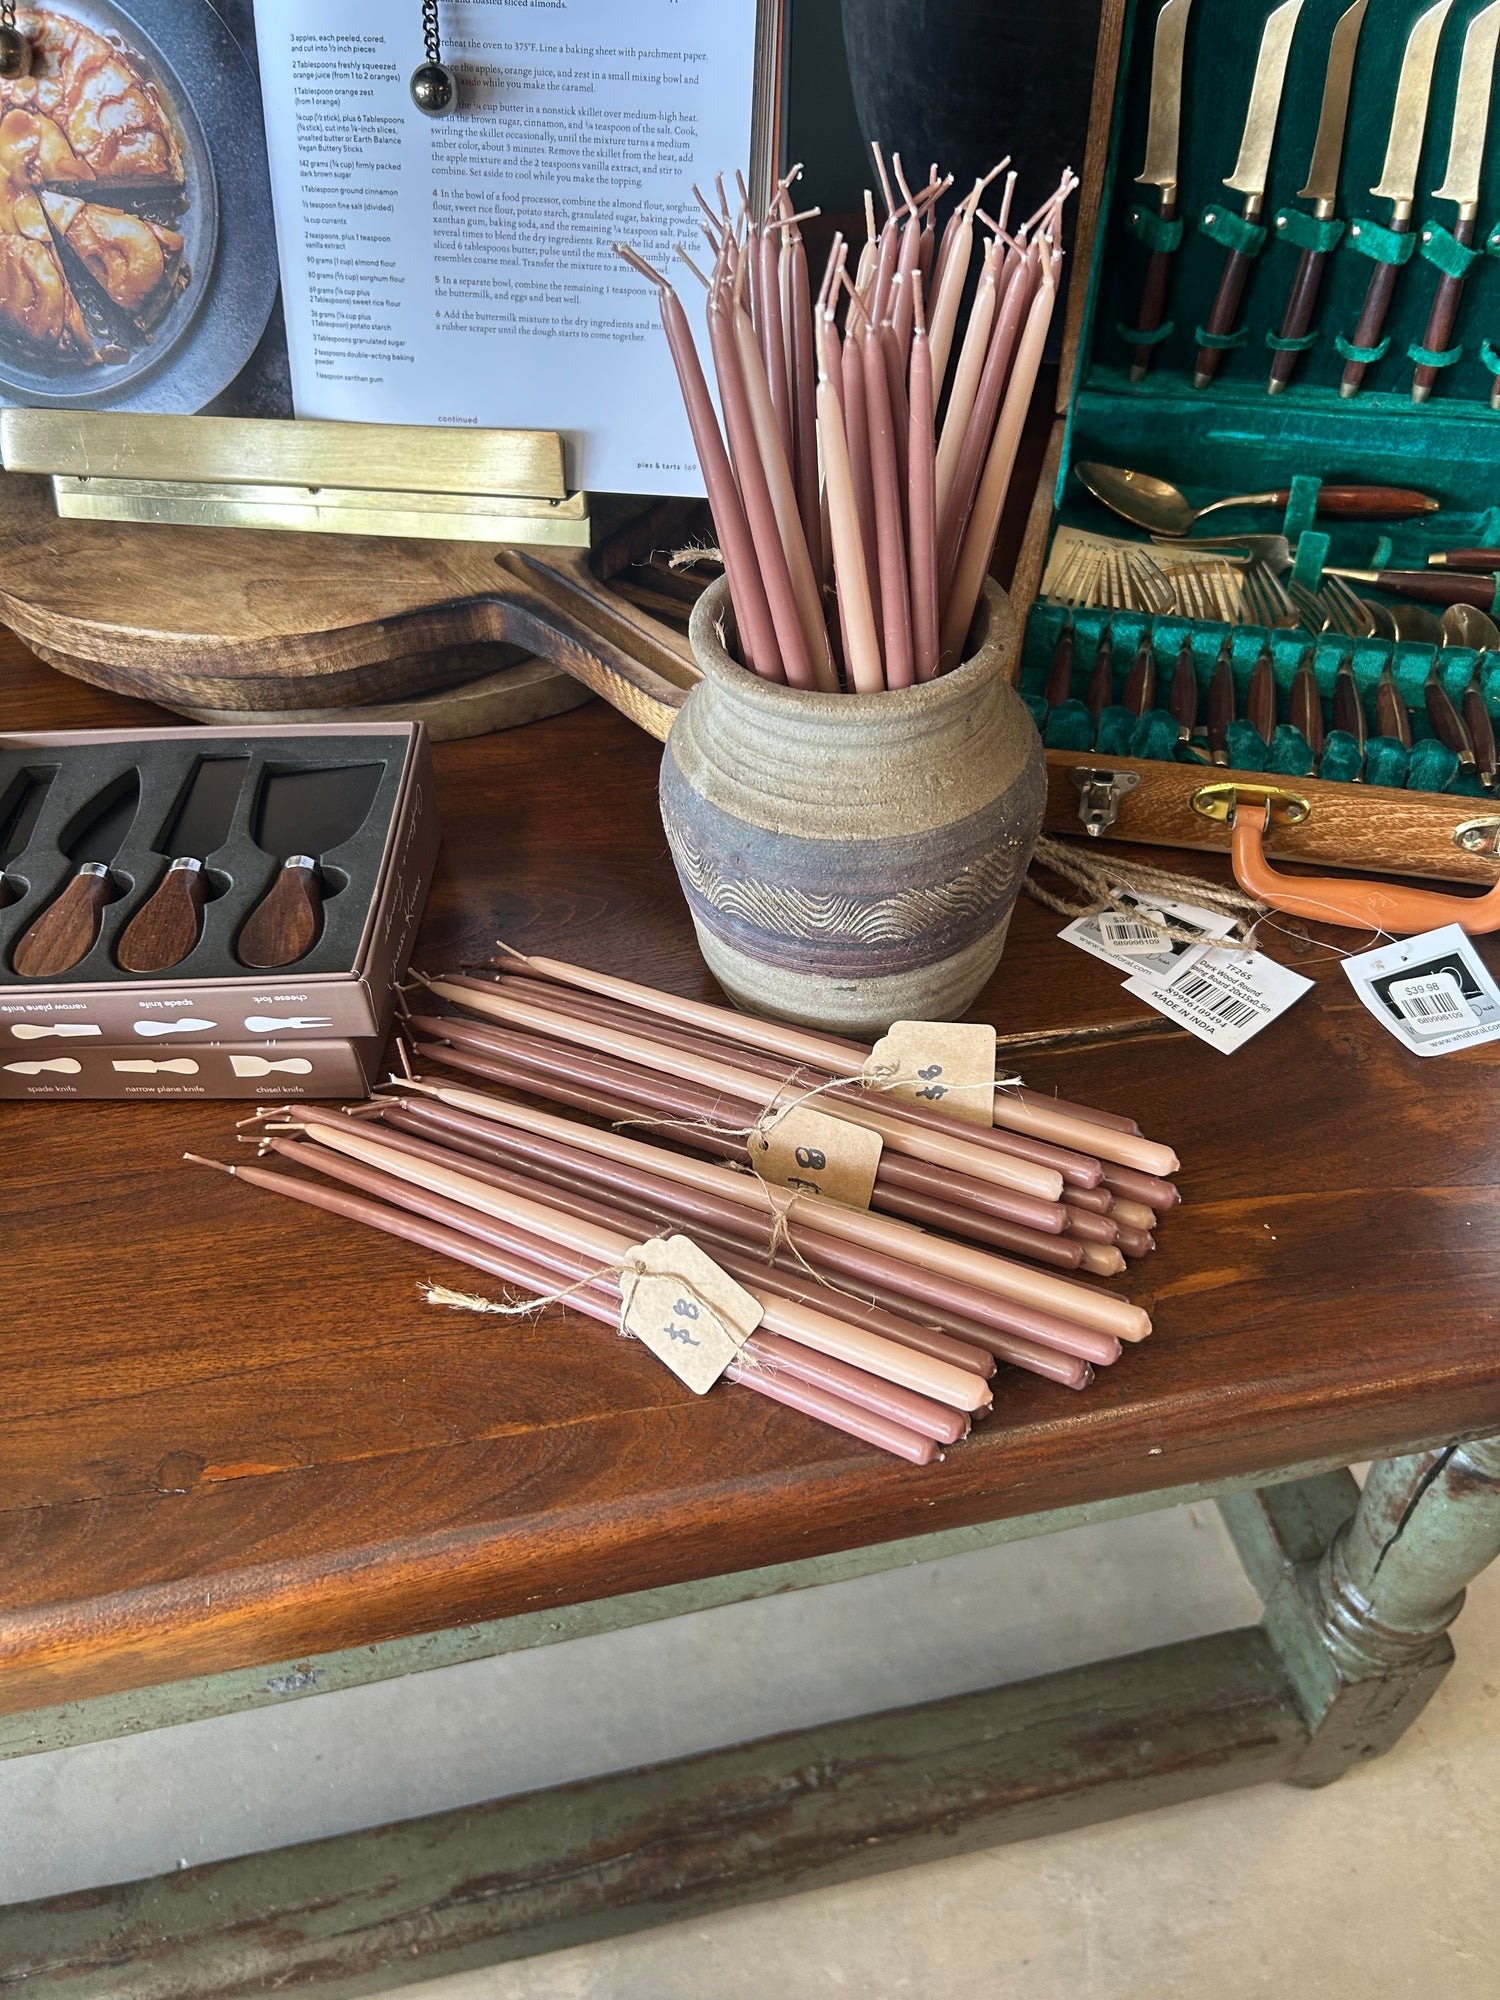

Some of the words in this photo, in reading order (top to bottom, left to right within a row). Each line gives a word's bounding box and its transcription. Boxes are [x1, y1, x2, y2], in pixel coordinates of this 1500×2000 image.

[441, 37, 467, 48] reheat
[467, 39, 482, 49] the
[482, 41, 503, 50] oven
[503, 40, 513, 51] to
[539, 42, 558, 53] Line
[558, 45, 565, 53] a
[564, 44, 594, 58] baking
[594, 45, 617, 56] sheet
[617, 46, 637, 57] with
[636, 48, 682, 62] parchment
[297, 61, 337, 71] Tablespoons
[337, 62, 361, 71] freshly
[361, 62, 396, 72] squeezed
[298, 87, 334, 97] Tablespoon
[334, 89, 359, 97] orange
[482, 78, 505, 88] while
[505, 81, 522, 92] you
[522, 79, 546, 90] make
[546, 81, 560, 91] the
[431, 125, 464, 139] swirling
[464, 127, 478, 137] the
[479, 128, 504, 139] skillet
[557, 132, 577, 143] until
[578, 133, 592, 143] the
[593, 134, 627, 145] mixture
[626, 136, 649, 146] turns
[649, 139, 656, 147] a
[656, 137, 690, 149] medium
[298, 144, 317, 153] Vegan
[317, 144, 342, 154] Buttery
[431, 151, 444, 162] the
[445, 152, 467, 166] apple
[468, 154, 502, 165] mixture
[502, 155, 518, 166] and
[519, 156, 533, 167] the
[533, 157, 540, 167] 2
[540, 158, 581, 173] teaspoons
[581, 160, 610, 171] vanilla
[642, 163, 657, 174] and
[658, 164, 673, 175] stir
[673, 165, 682, 175] to
[468, 167, 482, 177] Set
[482, 168, 504, 179] aside
[504, 169, 514, 179] to
[514, 170, 532, 180] cool
[532, 170, 555, 182] while
[555, 174, 572, 186] you
[572, 173, 594, 184] make
[596, 174, 609, 185] the
[305, 186, 339, 196] Tablespoon
[340, 187, 363, 197] ground
[454, 202, 477, 213] sweet
[477, 203, 494, 214] rice
[516, 205, 542, 220] potato
[570, 208, 614, 224] granulated
[640, 212, 668, 227] baking
[434, 286, 447, 296] the
[494, 289, 508, 300] and
[510, 292, 527, 304] eggs
[529, 291, 543, 302] and
[545, 292, 562, 303] beat
[435, 323, 441, 331] a
[441, 321, 467, 332] rubber
[469, 324, 496, 337] scraper
[498, 324, 516, 335] until
[518, 325, 531, 336] the
[532, 326, 556, 340] dough
[557, 327, 580, 338] starts
[580, 328, 589, 339] to
[589, 331, 611, 340] come
[438, 415, 478, 424] continued
[637, 462, 653, 470] pies
[1200, 960, 1217, 972] Dark
[1217, 970, 1236, 984] Wood
[1237, 982, 1263, 997] Round
[1226, 963, 1253, 980] TF265
[1208, 974, 1230, 988] Board
[1228, 987, 1271, 1013] 20x15x0.5in
[1405, 982, 1439, 996] $39.98
[2, 1005, 26, 1013] knife
[27, 1003, 52, 1011] plane
[166, 999, 194, 1007] spade
[1152, 991, 1179, 1010] MADE
[1178, 1008, 1190, 1017] IN
[1189, 1015, 1215, 1034] INDIA
[916, 1064, 948, 1100] $8
[664, 1298, 700, 1346] $8
